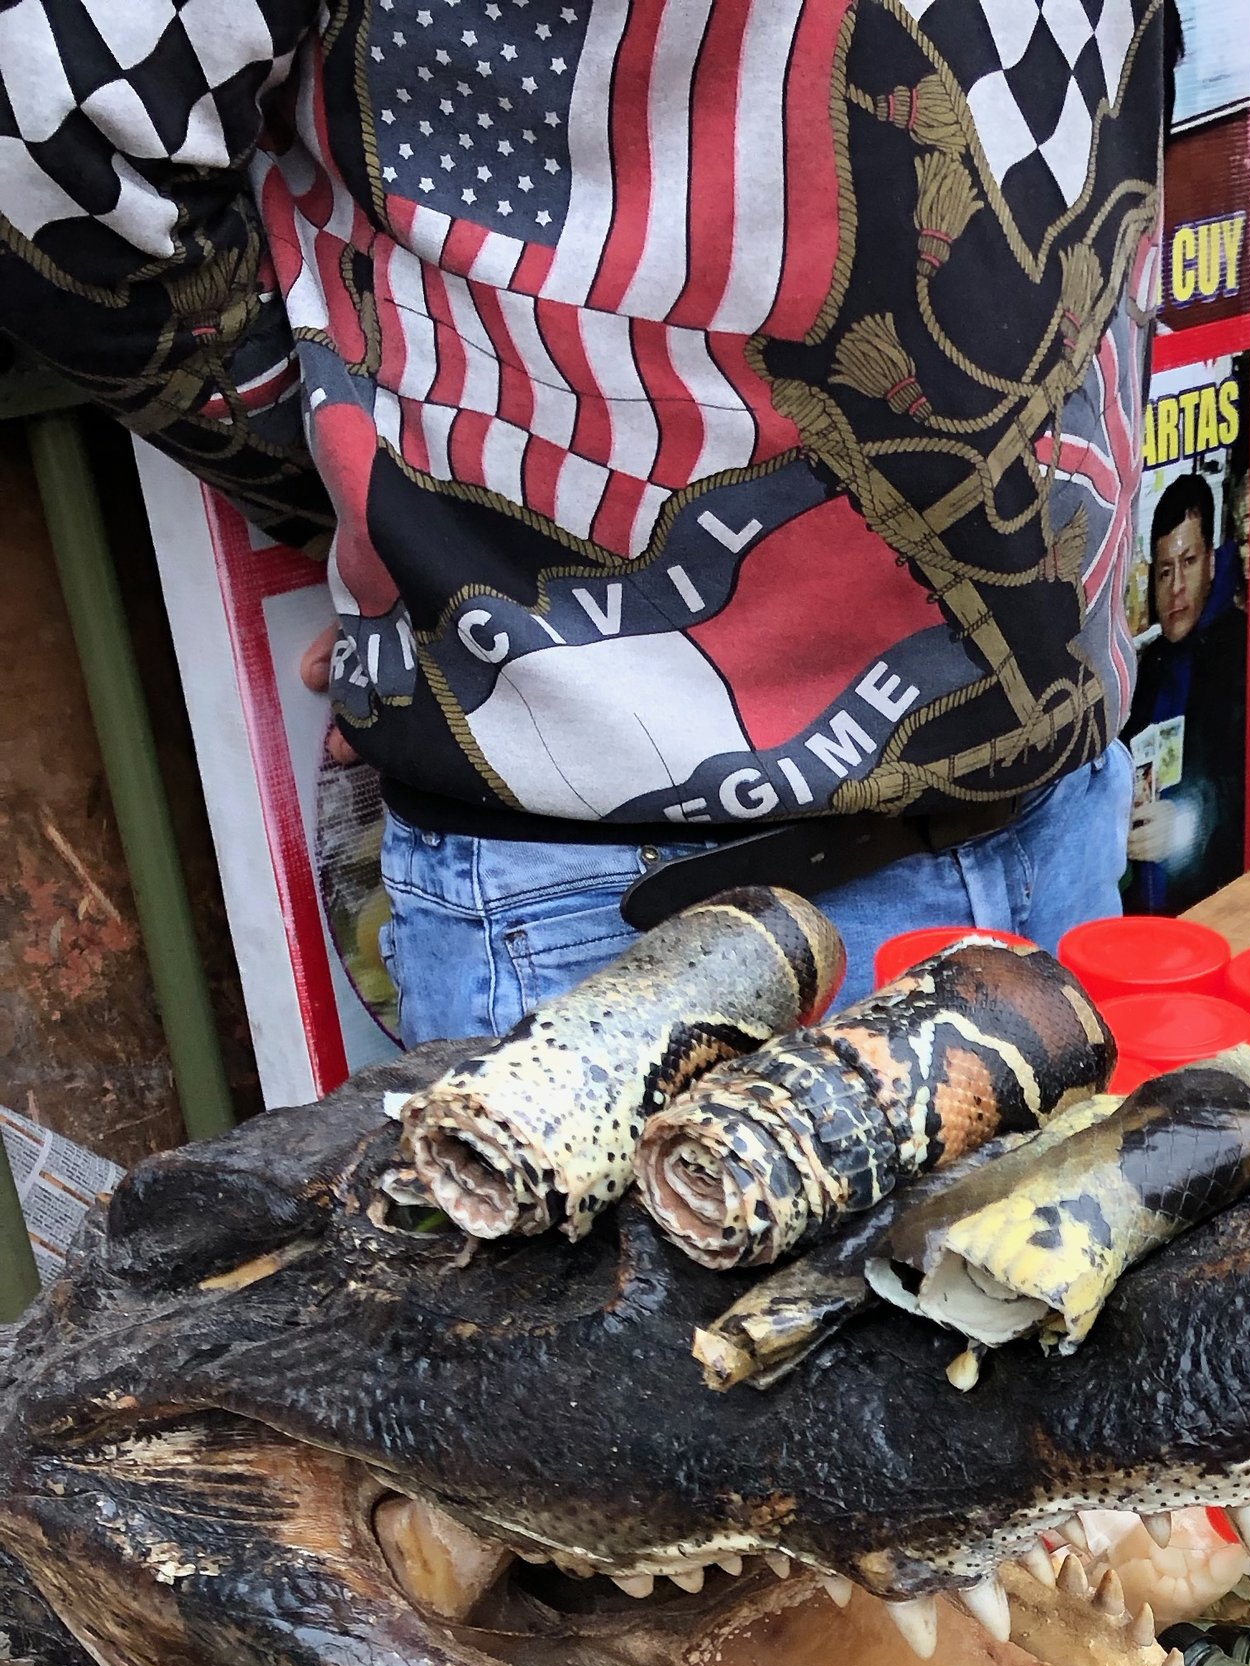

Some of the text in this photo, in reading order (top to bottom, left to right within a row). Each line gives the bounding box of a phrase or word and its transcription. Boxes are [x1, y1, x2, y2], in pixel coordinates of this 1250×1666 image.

[1171, 213, 1245, 304] CUY
[1143, 379, 1240, 467] ARTAS
[662, 660, 921, 823] EGIME
